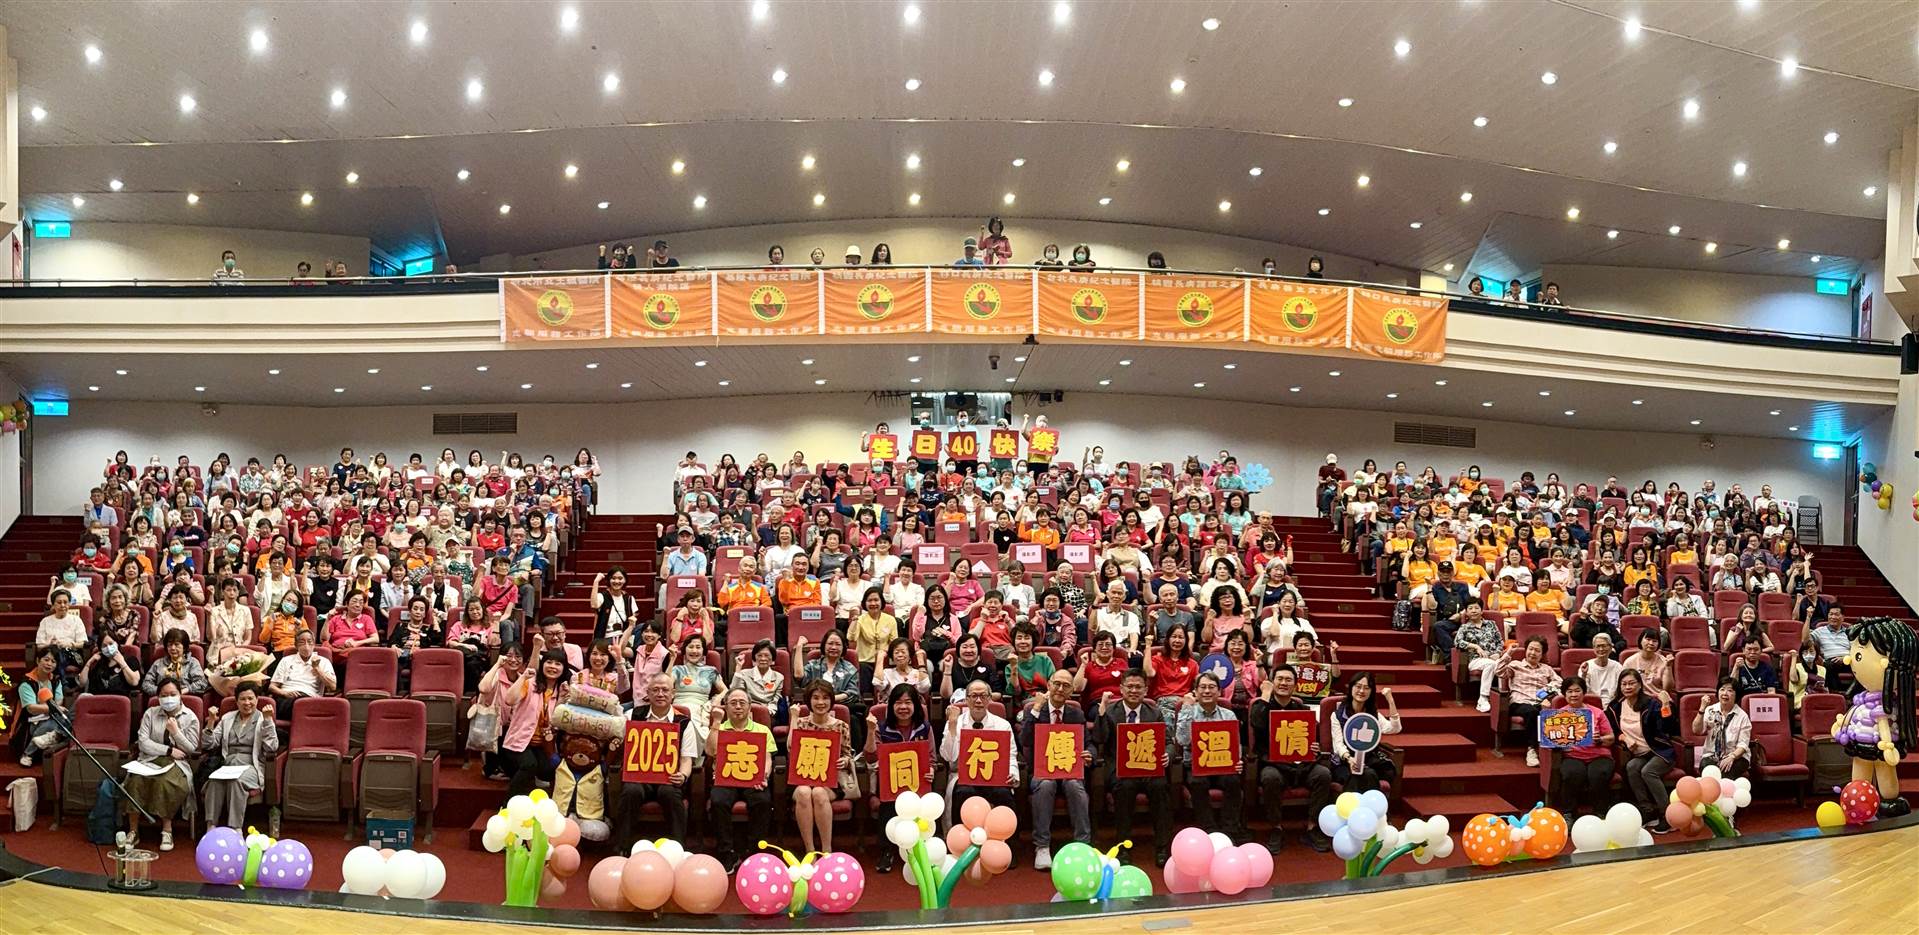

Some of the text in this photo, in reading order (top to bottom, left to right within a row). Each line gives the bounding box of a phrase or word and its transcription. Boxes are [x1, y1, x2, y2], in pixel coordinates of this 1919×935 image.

[871, 431, 1056, 459] 生 日 40 快 樂
[1568, 725, 1576, 740] 1
[626, 719, 1309, 794] 2025 志 願 同 行 傳 遞 溫 情
